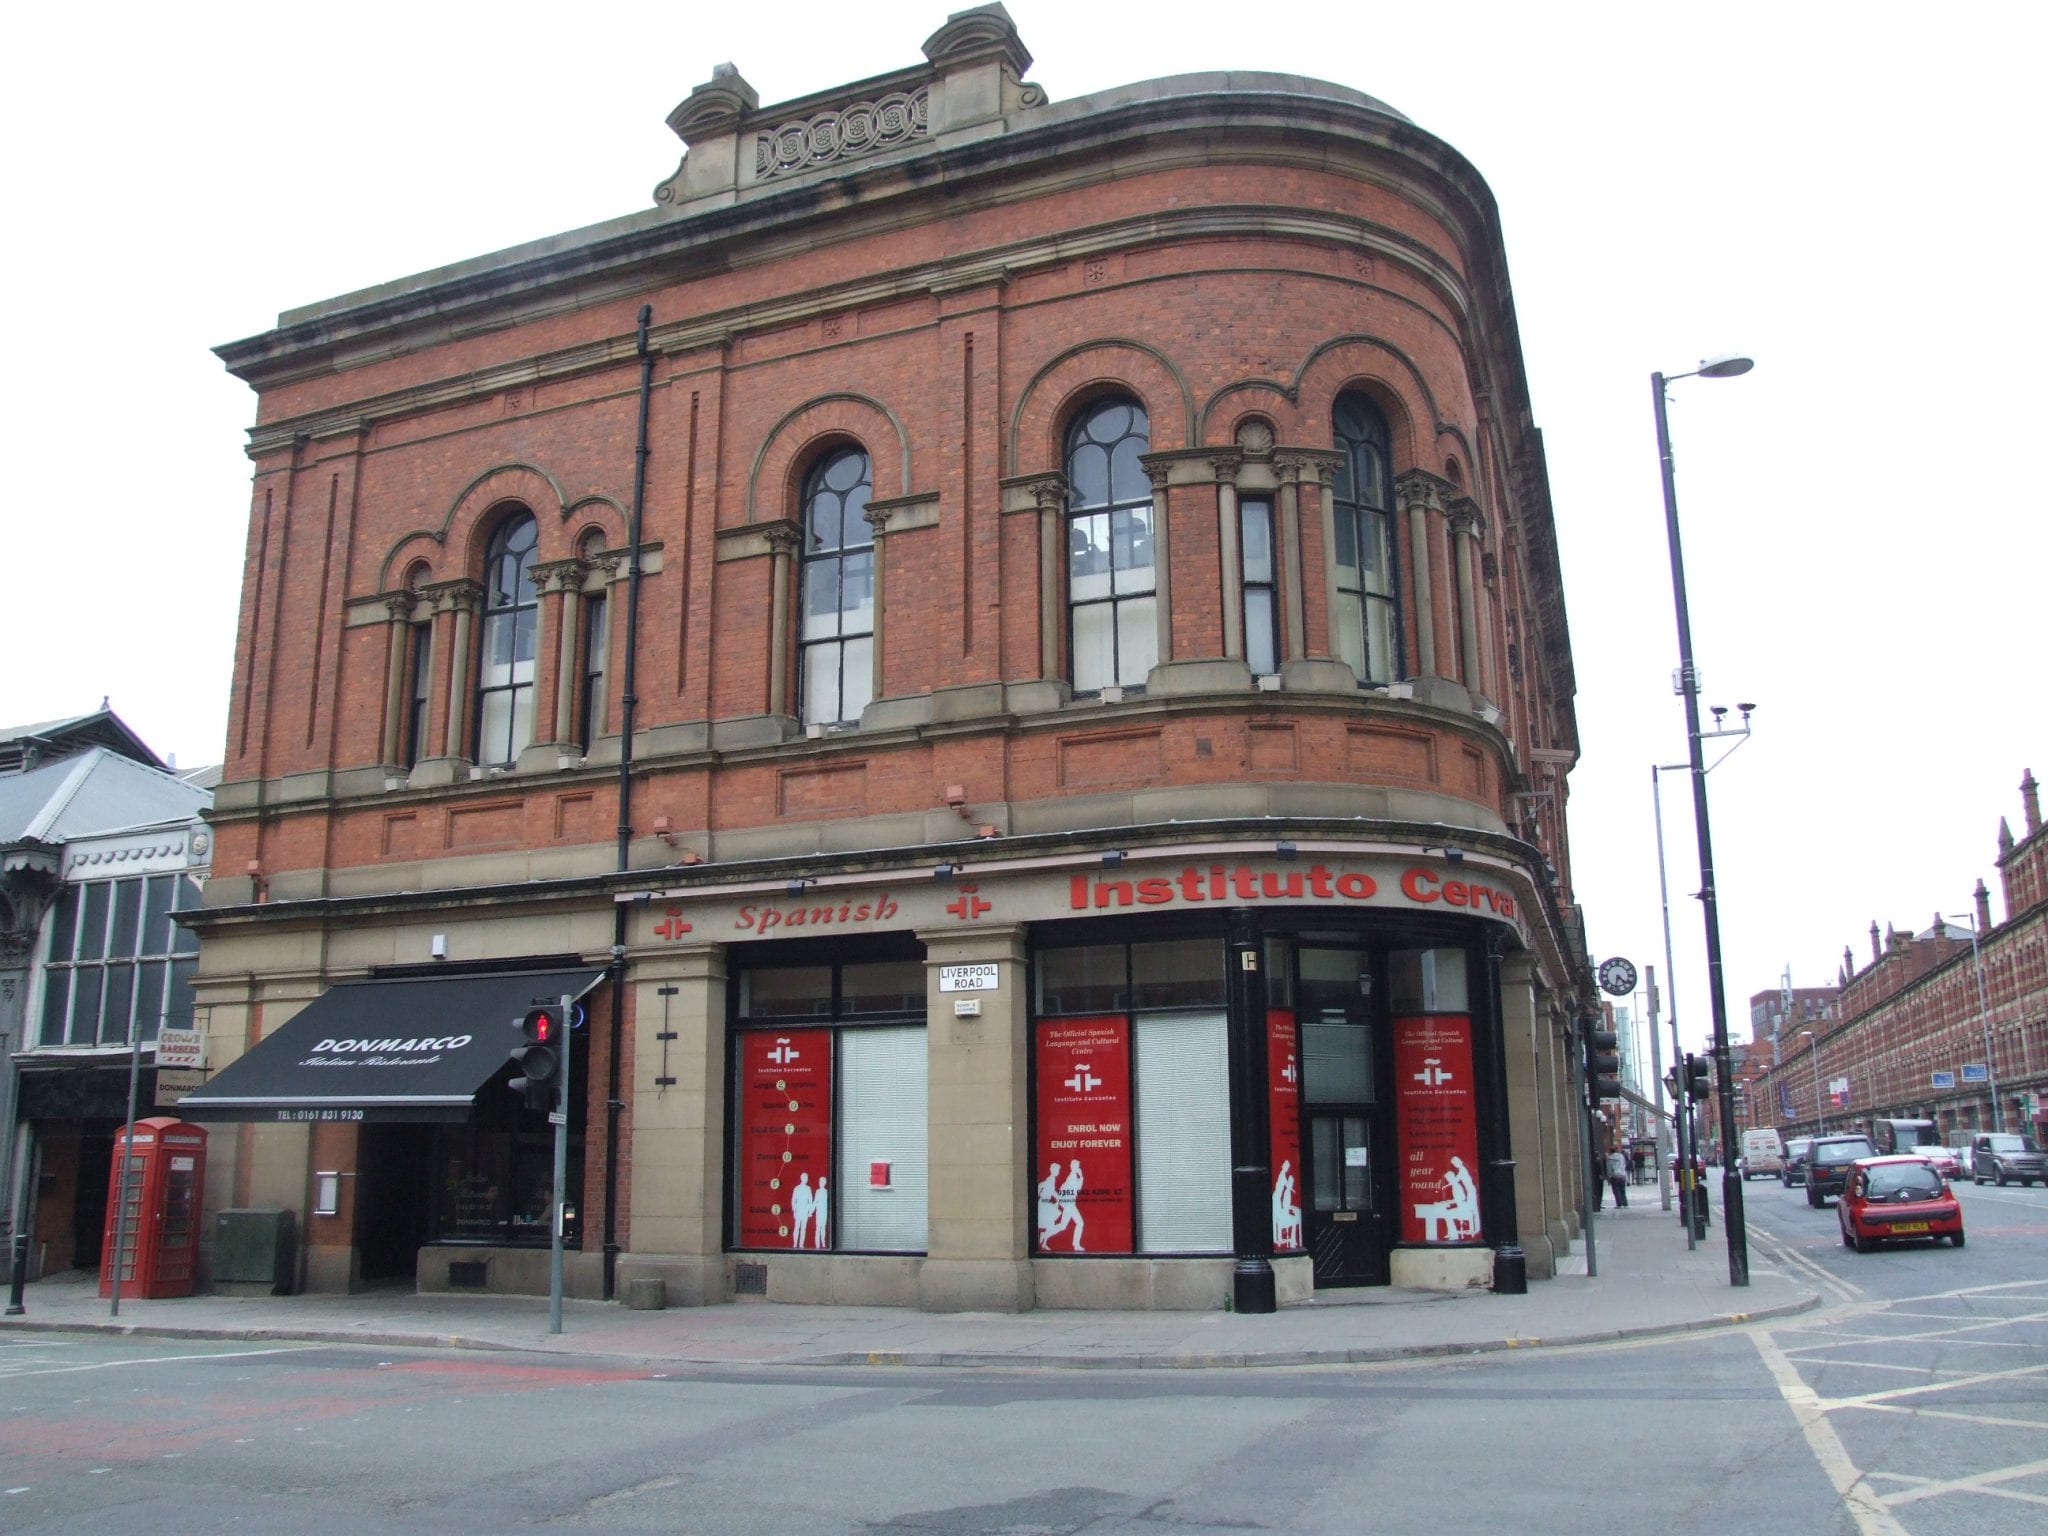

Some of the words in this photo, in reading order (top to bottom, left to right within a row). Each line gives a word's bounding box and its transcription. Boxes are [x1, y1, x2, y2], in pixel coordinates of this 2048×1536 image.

[1069, 864, 1377, 909] Instituto
[735, 893, 898, 934] Spanish
[941, 966, 997, 978] LIVERPOOL
[954, 978, 983, 989] ROAD
[1063, 1030, 1087, 1038] Official
[1088, 1028, 1115, 1037] Spanish
[311, 1035, 473, 1052] DONMARCO
[1046, 1040, 1076, 1048] Language
[1091, 1037, 1120, 1045] Cultural
[160, 1045, 200, 1054] BARBERS
[299, 1057, 357, 1067] Italian
[359, 1055, 442, 1067] Ristorante
[278, 1111, 291, 1120] TEL
[298, 1111, 319, 1120] 0161
[322, 1111, 338, 1120] 831
[341, 1111, 364, 1120] 9130
[1067, 1124, 1098, 1133] ENROL
[1099, 1124, 1121, 1132] NOW
[1051, 1140, 1078, 1149] ENJOY
[1080, 1139, 1121, 1148] FOREVER
[1409, 1151, 1424, 1161] all
[1409, 1167, 1434, 1177] year
[1410, 1179, 1442, 1190] round
